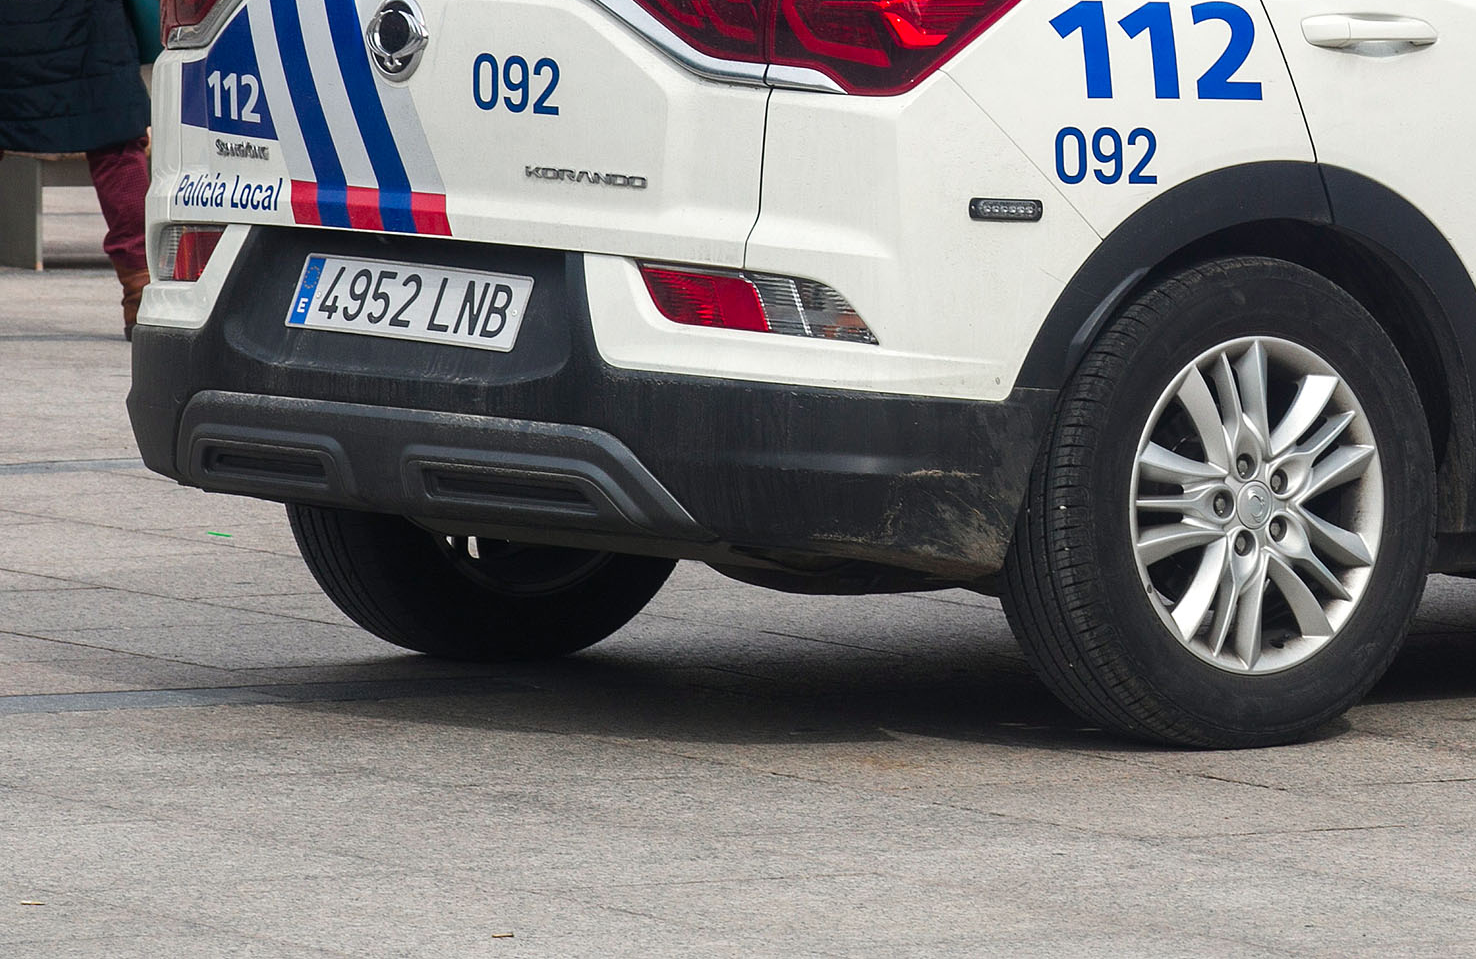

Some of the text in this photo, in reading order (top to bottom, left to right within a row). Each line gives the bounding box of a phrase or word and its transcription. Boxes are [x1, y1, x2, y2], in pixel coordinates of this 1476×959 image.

[1048, 0, 1263, 100] 112
[207, 70, 261, 123] 112
[472, 52, 561, 116] 092
[524, 165, 648, 189] KORANDO
[1054, 127, 1158, 185] 092
[174, 172, 284, 211] Policía Local
[296, 266, 514, 339] E 4952 LNB
